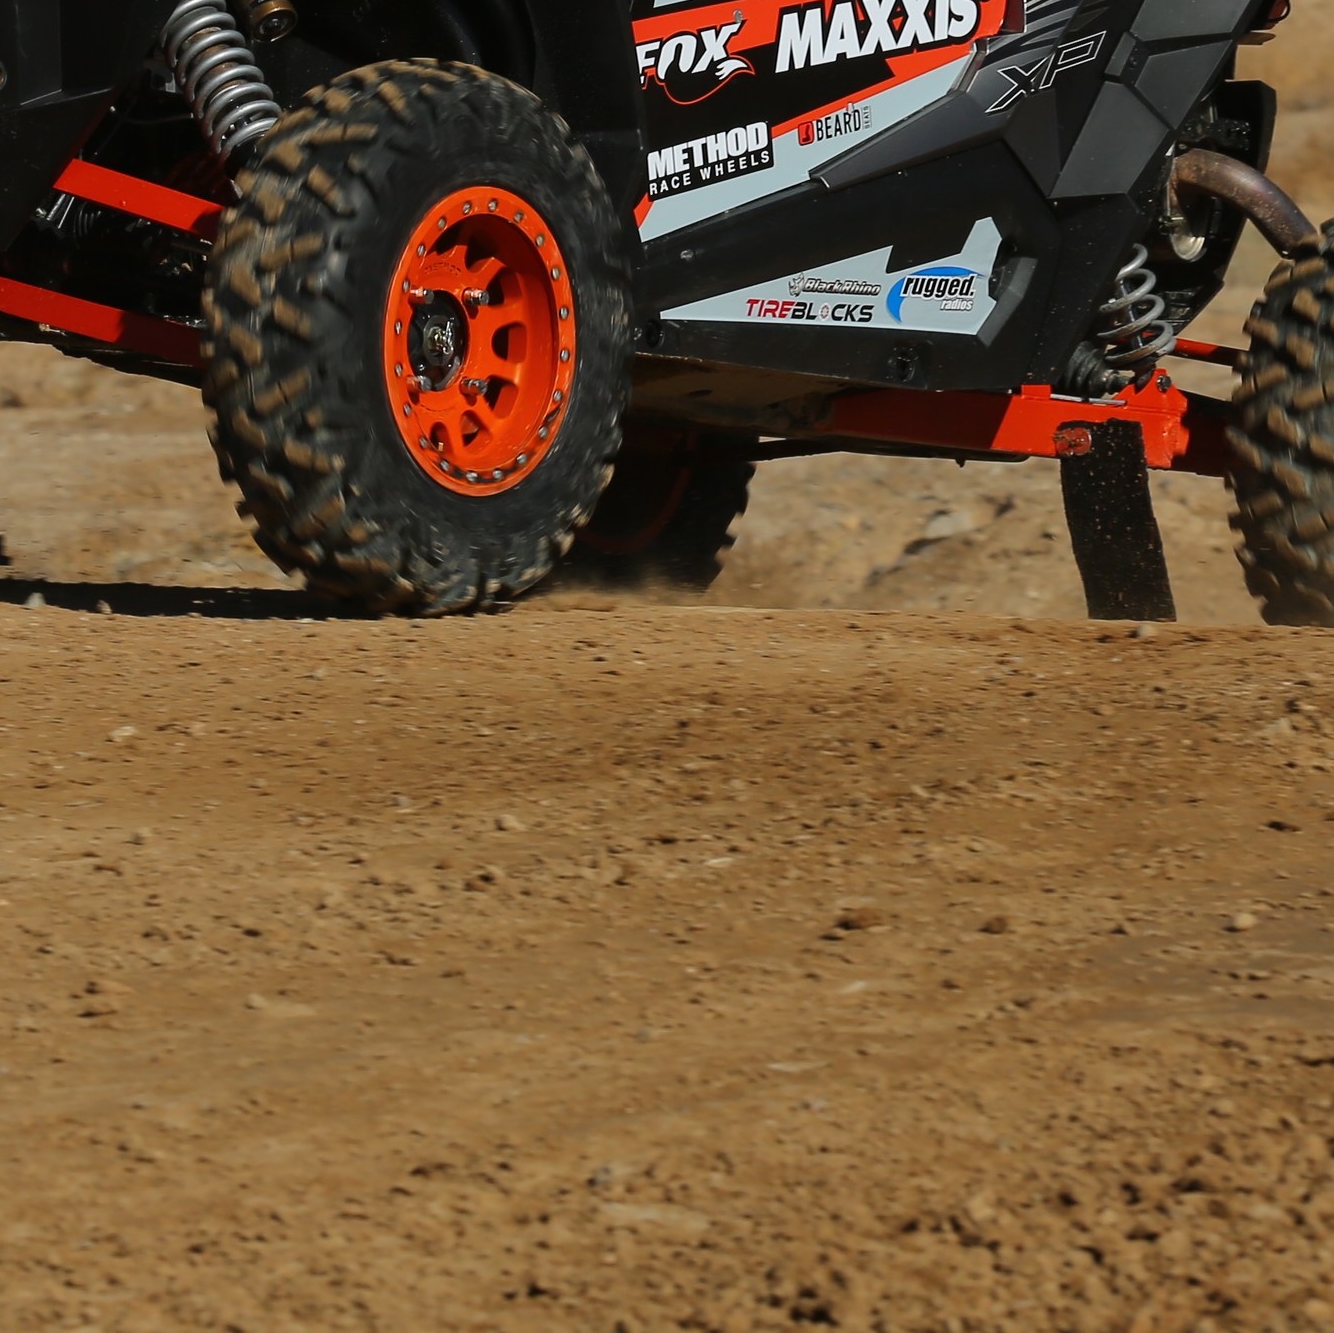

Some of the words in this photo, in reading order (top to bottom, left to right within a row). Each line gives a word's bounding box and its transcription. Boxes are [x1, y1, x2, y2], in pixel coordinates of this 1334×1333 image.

[635, 20, 745, 84] FOX
[985, 30, 1107, 113] XP
[647, 120, 769, 181] METHOD
[815, 109, 862, 142] BEARD
[648, 173, 692, 197] RACE
[699, 150, 771, 181] WHEELS
[939, 298, 973, 311] radios
